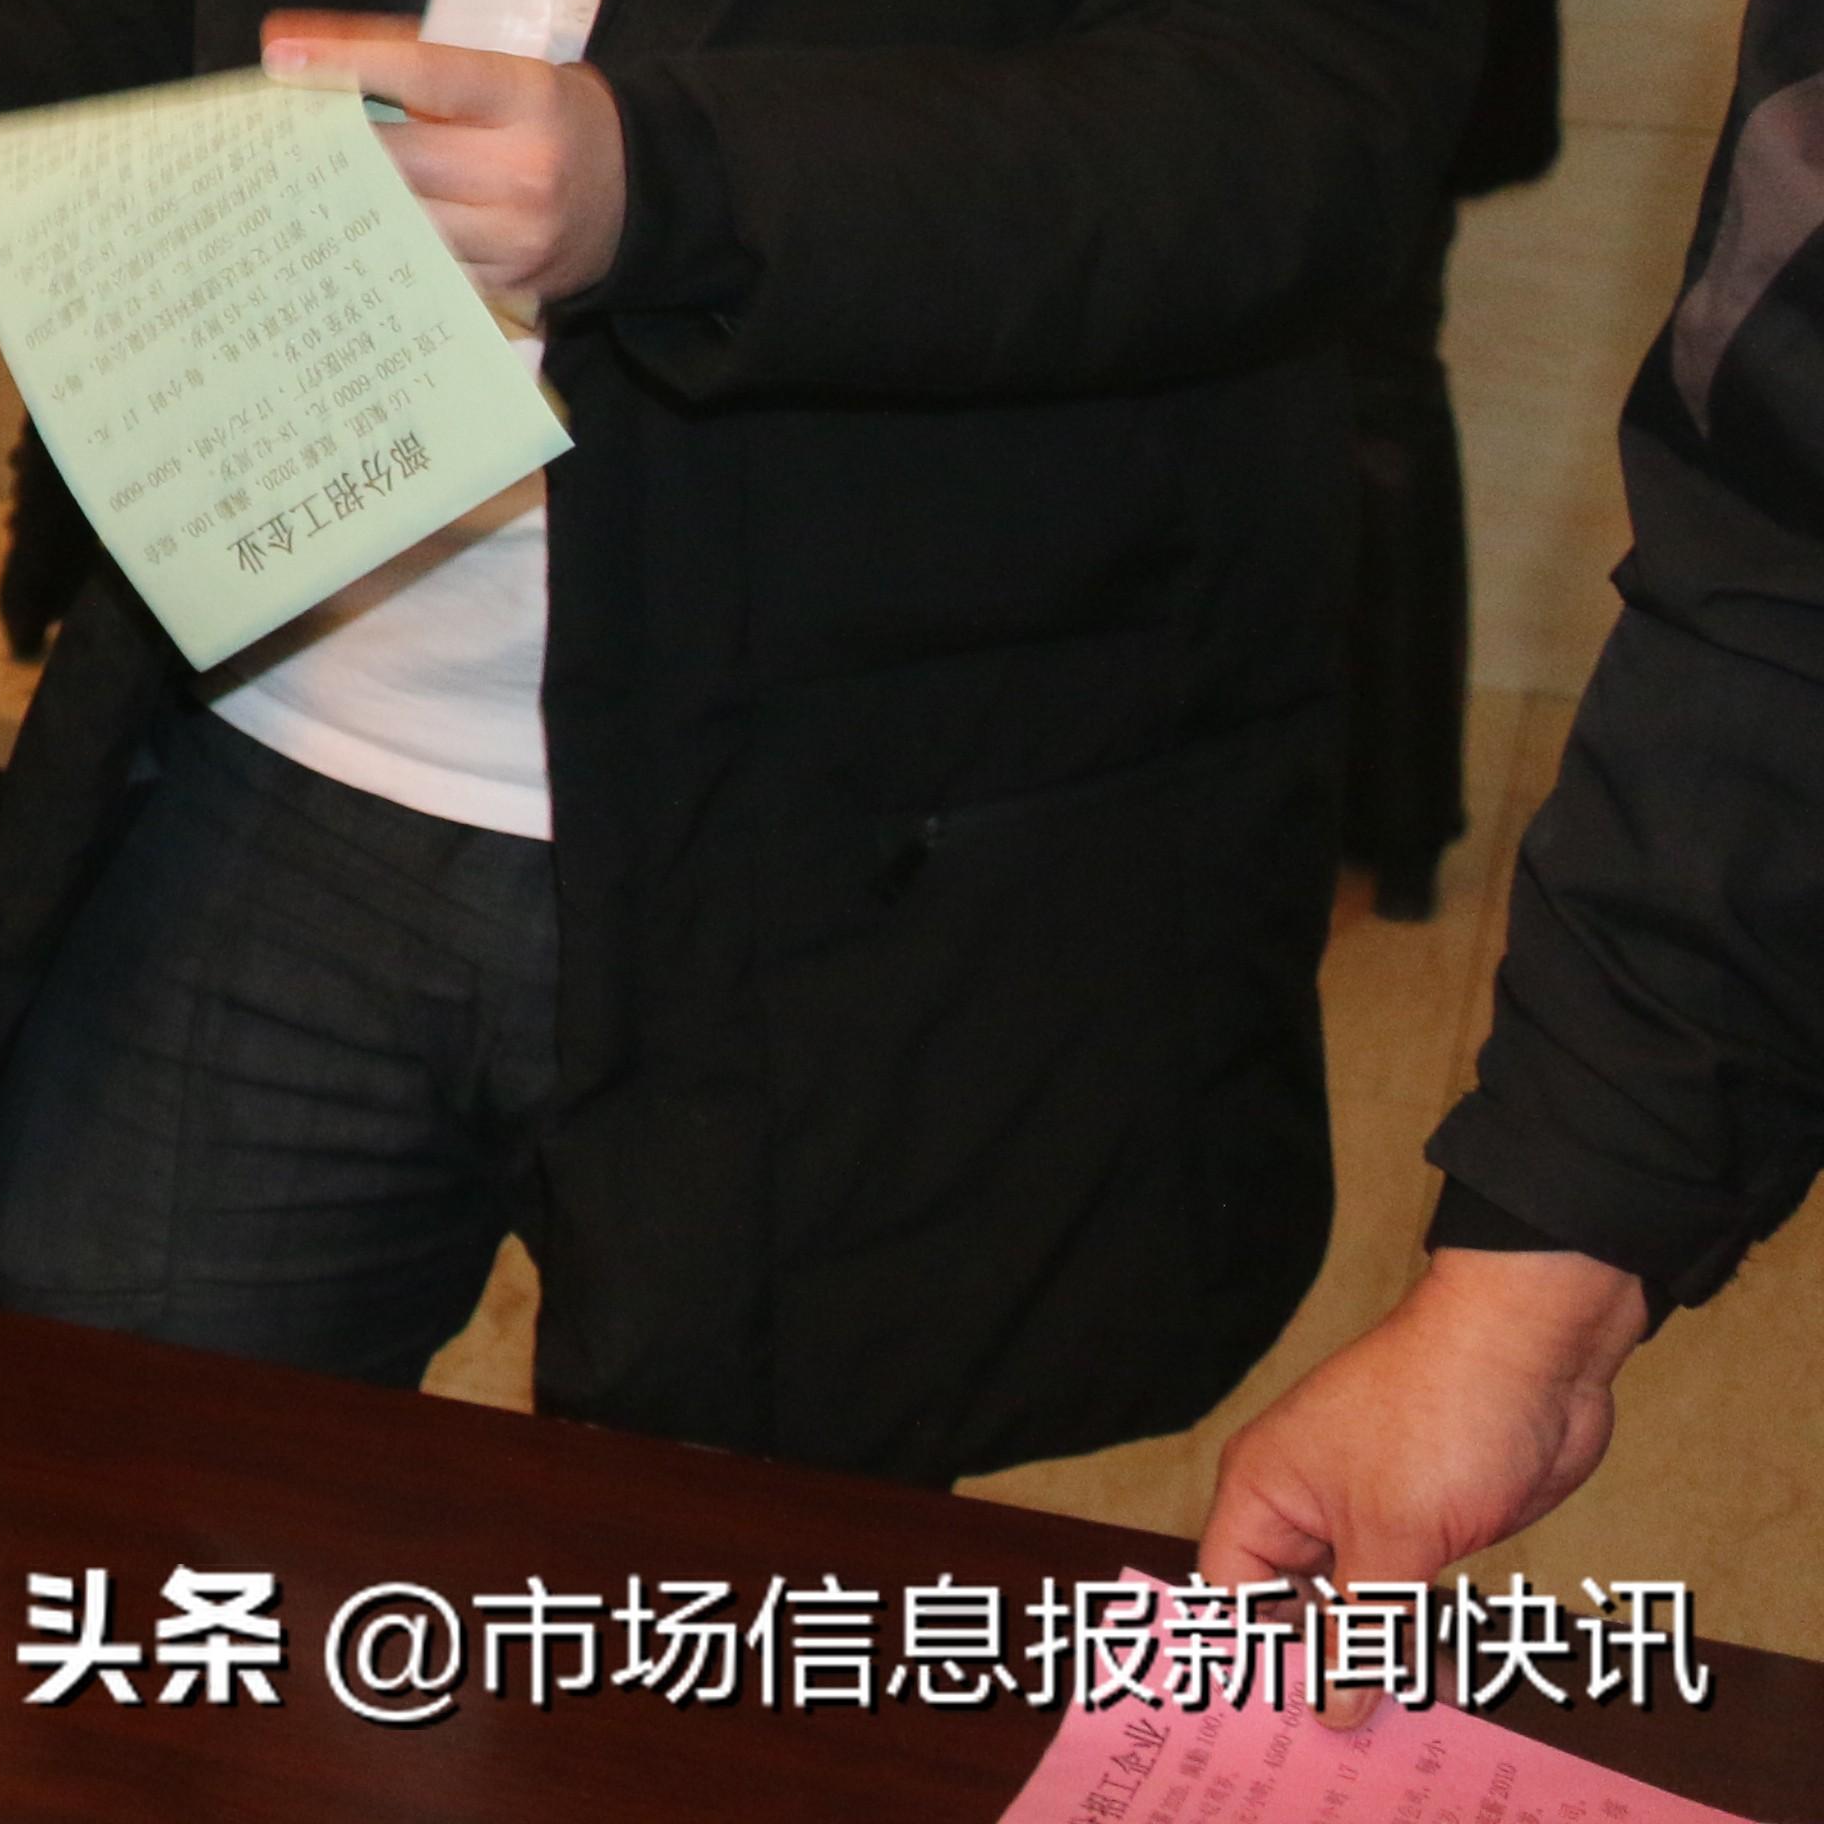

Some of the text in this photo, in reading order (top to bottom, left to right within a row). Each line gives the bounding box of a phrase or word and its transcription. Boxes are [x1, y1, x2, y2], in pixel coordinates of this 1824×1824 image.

[224, 428, 433, 581] 部分招工企业
